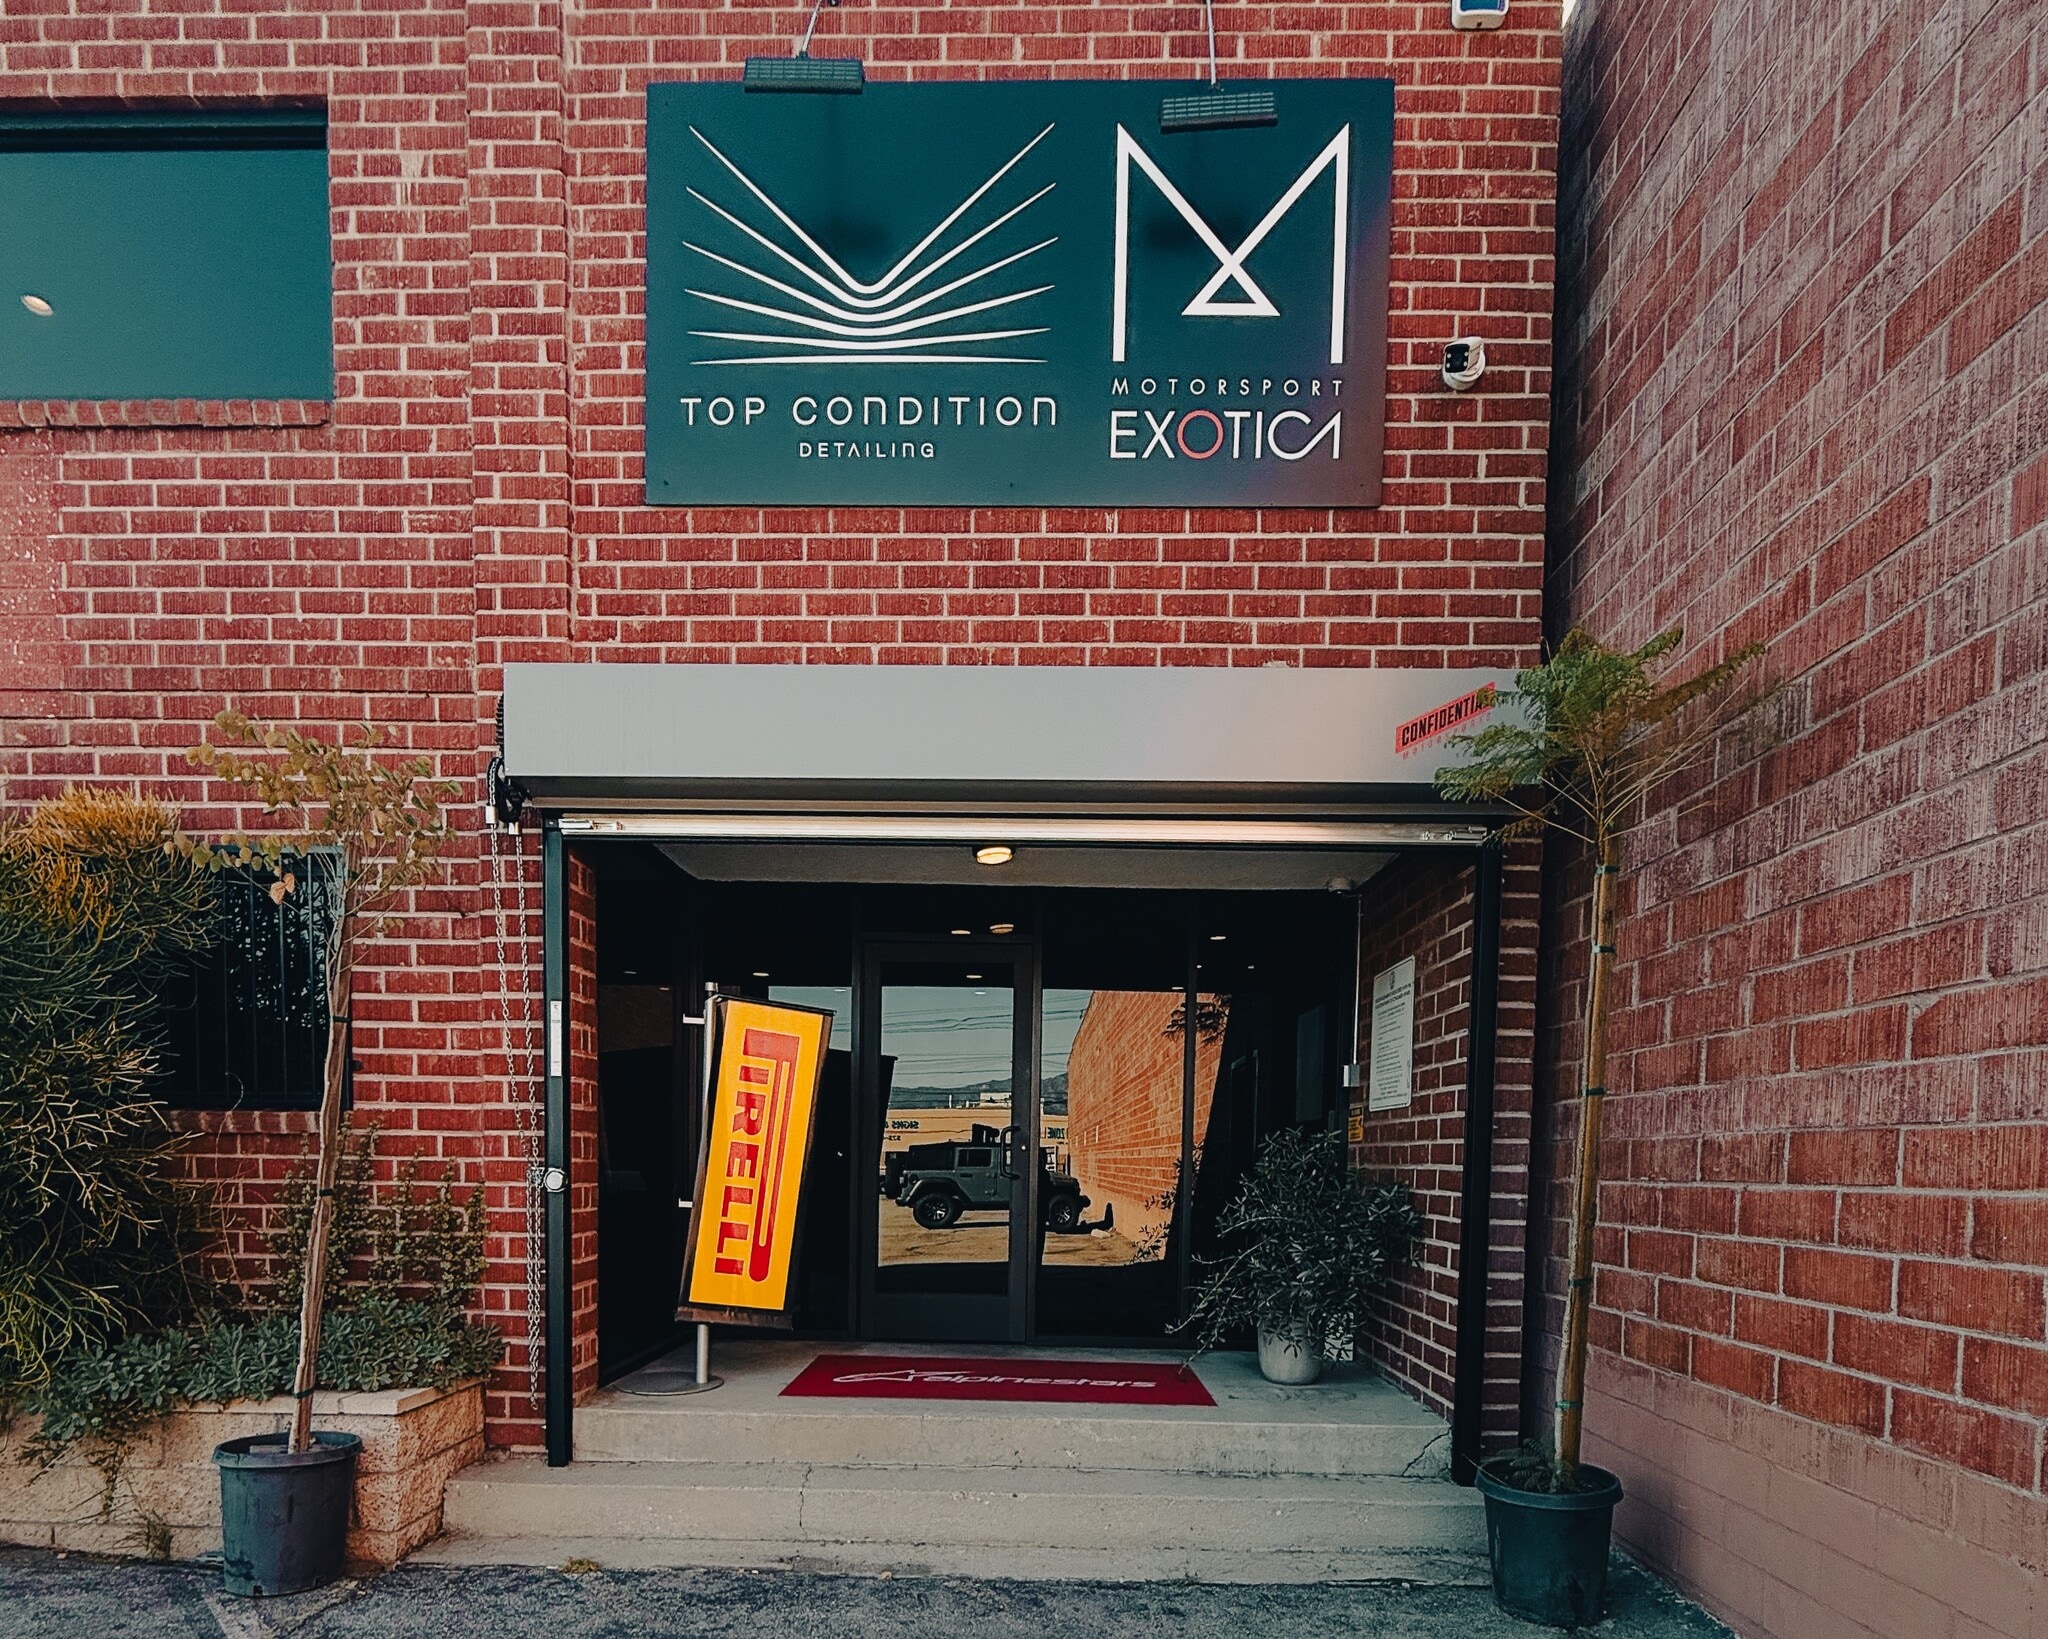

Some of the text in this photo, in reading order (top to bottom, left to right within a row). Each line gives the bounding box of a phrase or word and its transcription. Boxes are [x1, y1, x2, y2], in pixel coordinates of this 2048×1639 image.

[1112, 377, 1342, 396] MOTORSPORT
[680, 396, 1057, 426] TOP CONDITION
[1110, 409, 1341, 460] EXOTICA
[799, 442, 935, 458] DETAILING
[713, 1028, 800, 1282] PIRELLI
[923, 1375, 1157, 1388] alpinestars
